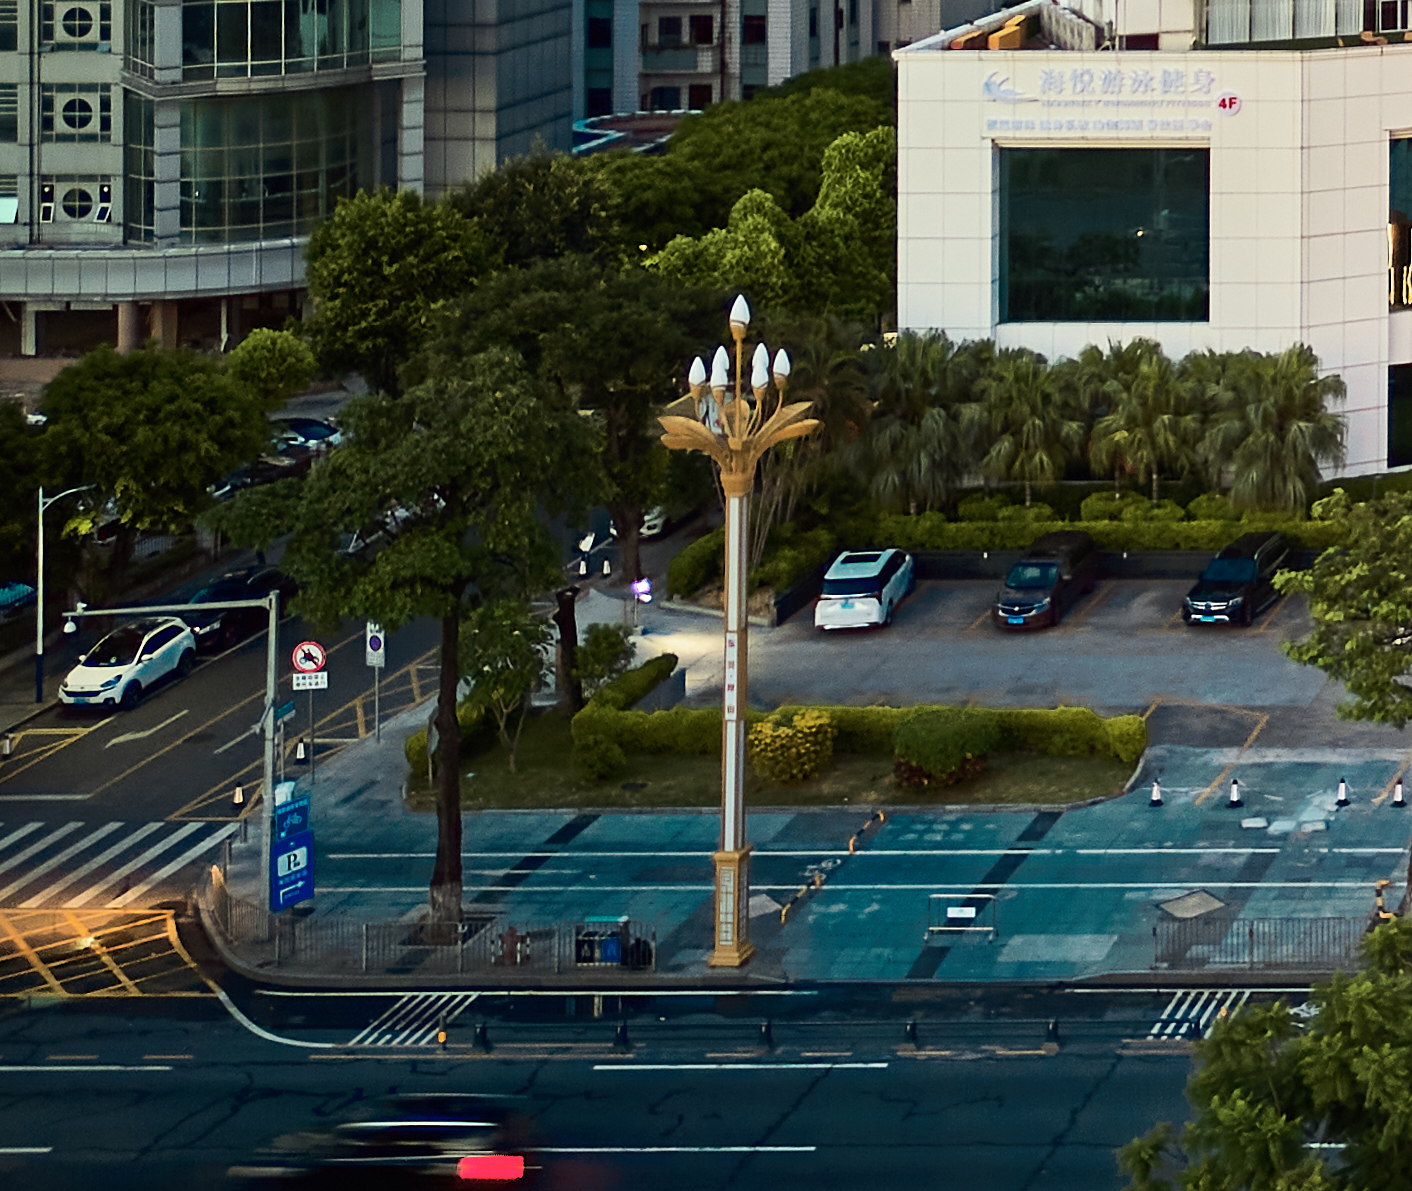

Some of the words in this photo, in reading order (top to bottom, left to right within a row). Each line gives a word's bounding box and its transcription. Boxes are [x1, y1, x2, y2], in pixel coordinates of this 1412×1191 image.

[1040, 68, 1215, 96] 海悦游泳健身
[1218, 97, 1238, 110] 4F
